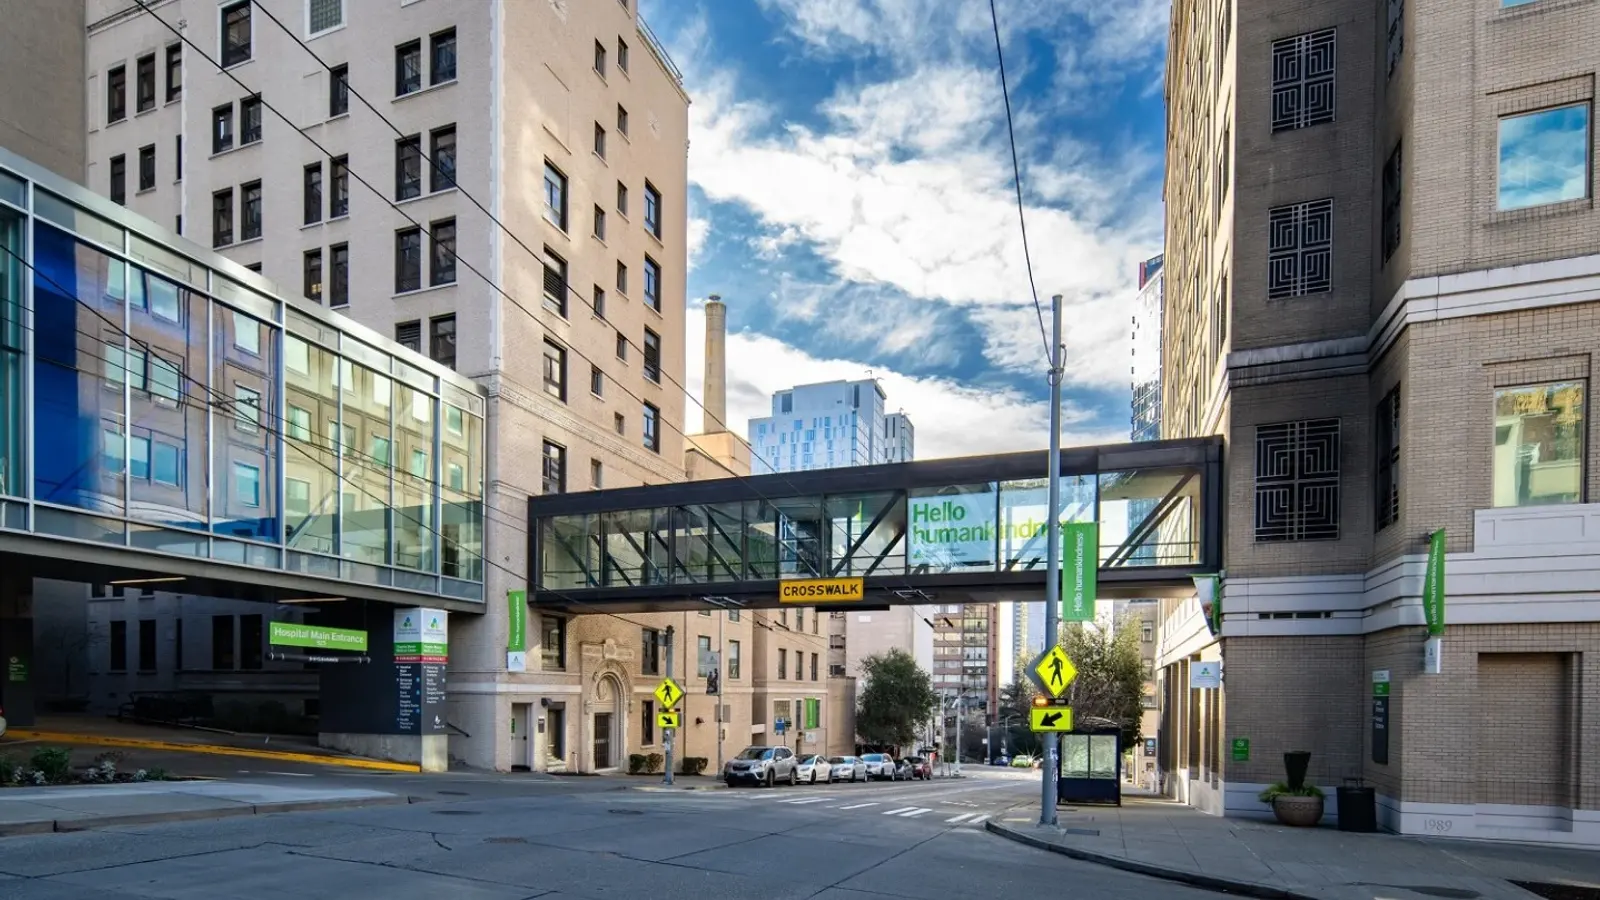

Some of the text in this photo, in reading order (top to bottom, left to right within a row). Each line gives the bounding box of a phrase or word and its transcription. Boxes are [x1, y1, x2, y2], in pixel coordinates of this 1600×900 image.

[913, 501, 965, 523] Hello
[1074, 533, 1084, 612] Hello humankindness
[783, 583, 859, 597] CROSSWALK
[274, 627, 364, 644] Hospital Main Entrance
[1424, 818, 1453, 832] 1989
